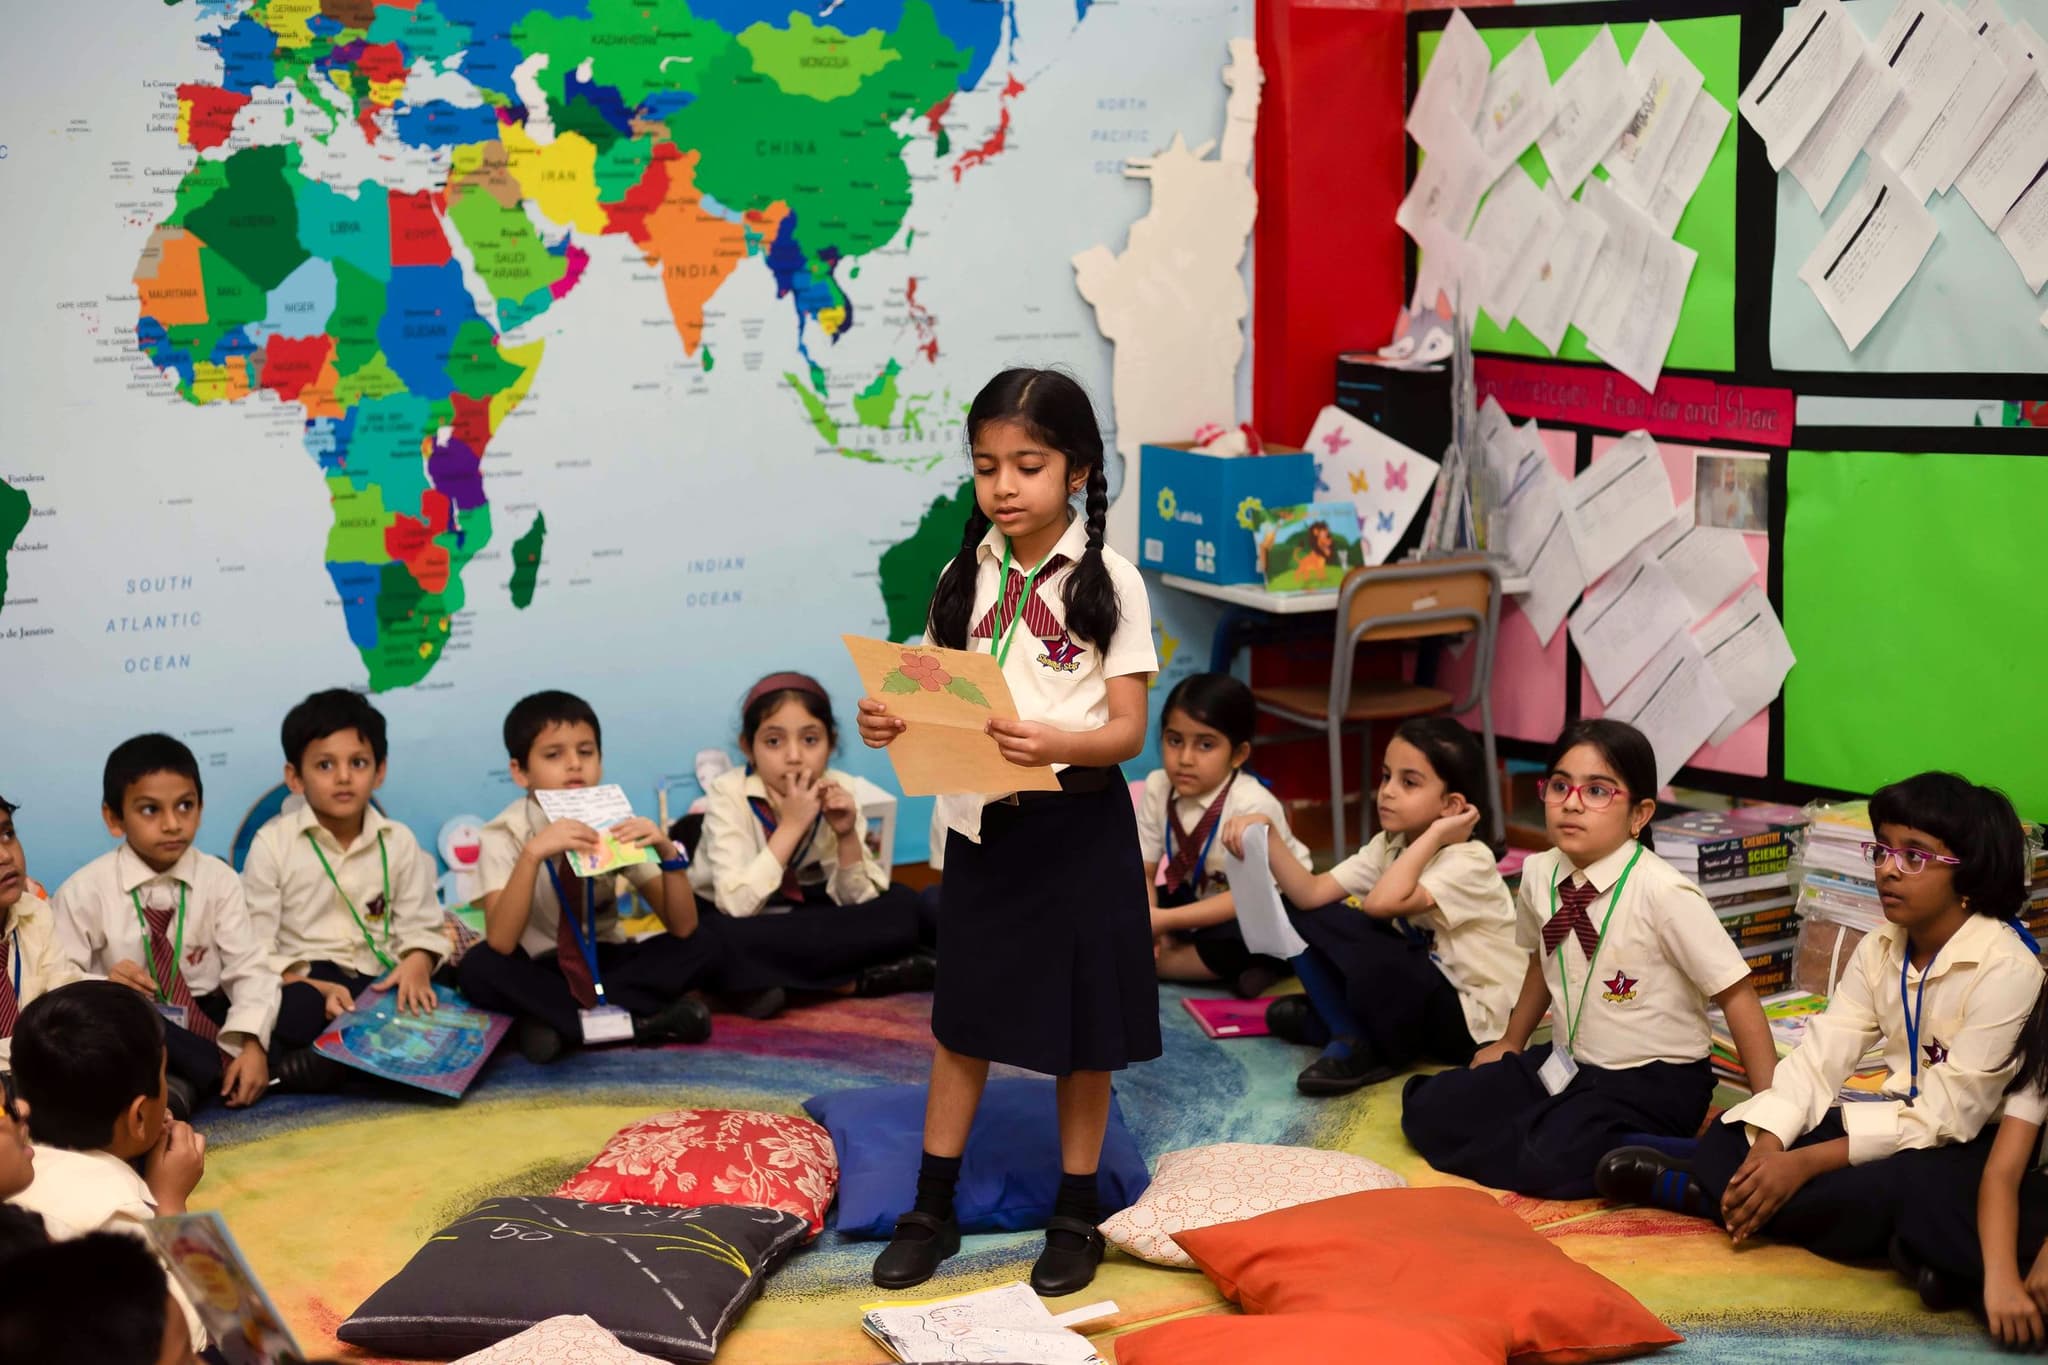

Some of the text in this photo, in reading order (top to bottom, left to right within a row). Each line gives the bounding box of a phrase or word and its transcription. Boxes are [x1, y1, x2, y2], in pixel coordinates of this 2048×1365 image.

[756, 139, 817, 156] CHINA
[144, 168, 188, 177] Casablanca
[541, 171, 576, 182] IRAN
[329, 222, 361, 235] LIBYA
[494, 252, 526, 264] SAUDI
[493, 267, 531, 279] ARABIA
[667, 264, 720, 279] INDIA
[148, 288, 198, 298] MAURITANIA
[285, 302, 315, 312] NIGER
[404, 325, 447, 338] SUDAN
[1684, 389, 1719, 426] and
[1724, 389, 1779, 431] Share
[8, 474, 45, 484] Fortaleza
[32, 508, 57, 517] Recife
[339, 517, 377, 528] ANGOLA
[14, 541, 49, 552] Salvador
[687, 557, 746, 574] INDIAN
[127, 576, 193, 594] SOUTH
[686, 591, 742, 608] OCEAN
[105, 612, 201, 633] ATLANTIC
[6, 629, 17, 638] de
[19, 625, 54, 640] Janeiro
[124, 655, 191, 673] OCEAN
[1742, 832, 1780, 848] CHEMISTRY
[1748, 844, 1788, 863] SCIENCE
[1748, 860, 1788, 877] SCIENCE
[1746, 954, 1772, 969] OLOGY
[489, 1222, 554, 1242] 50
